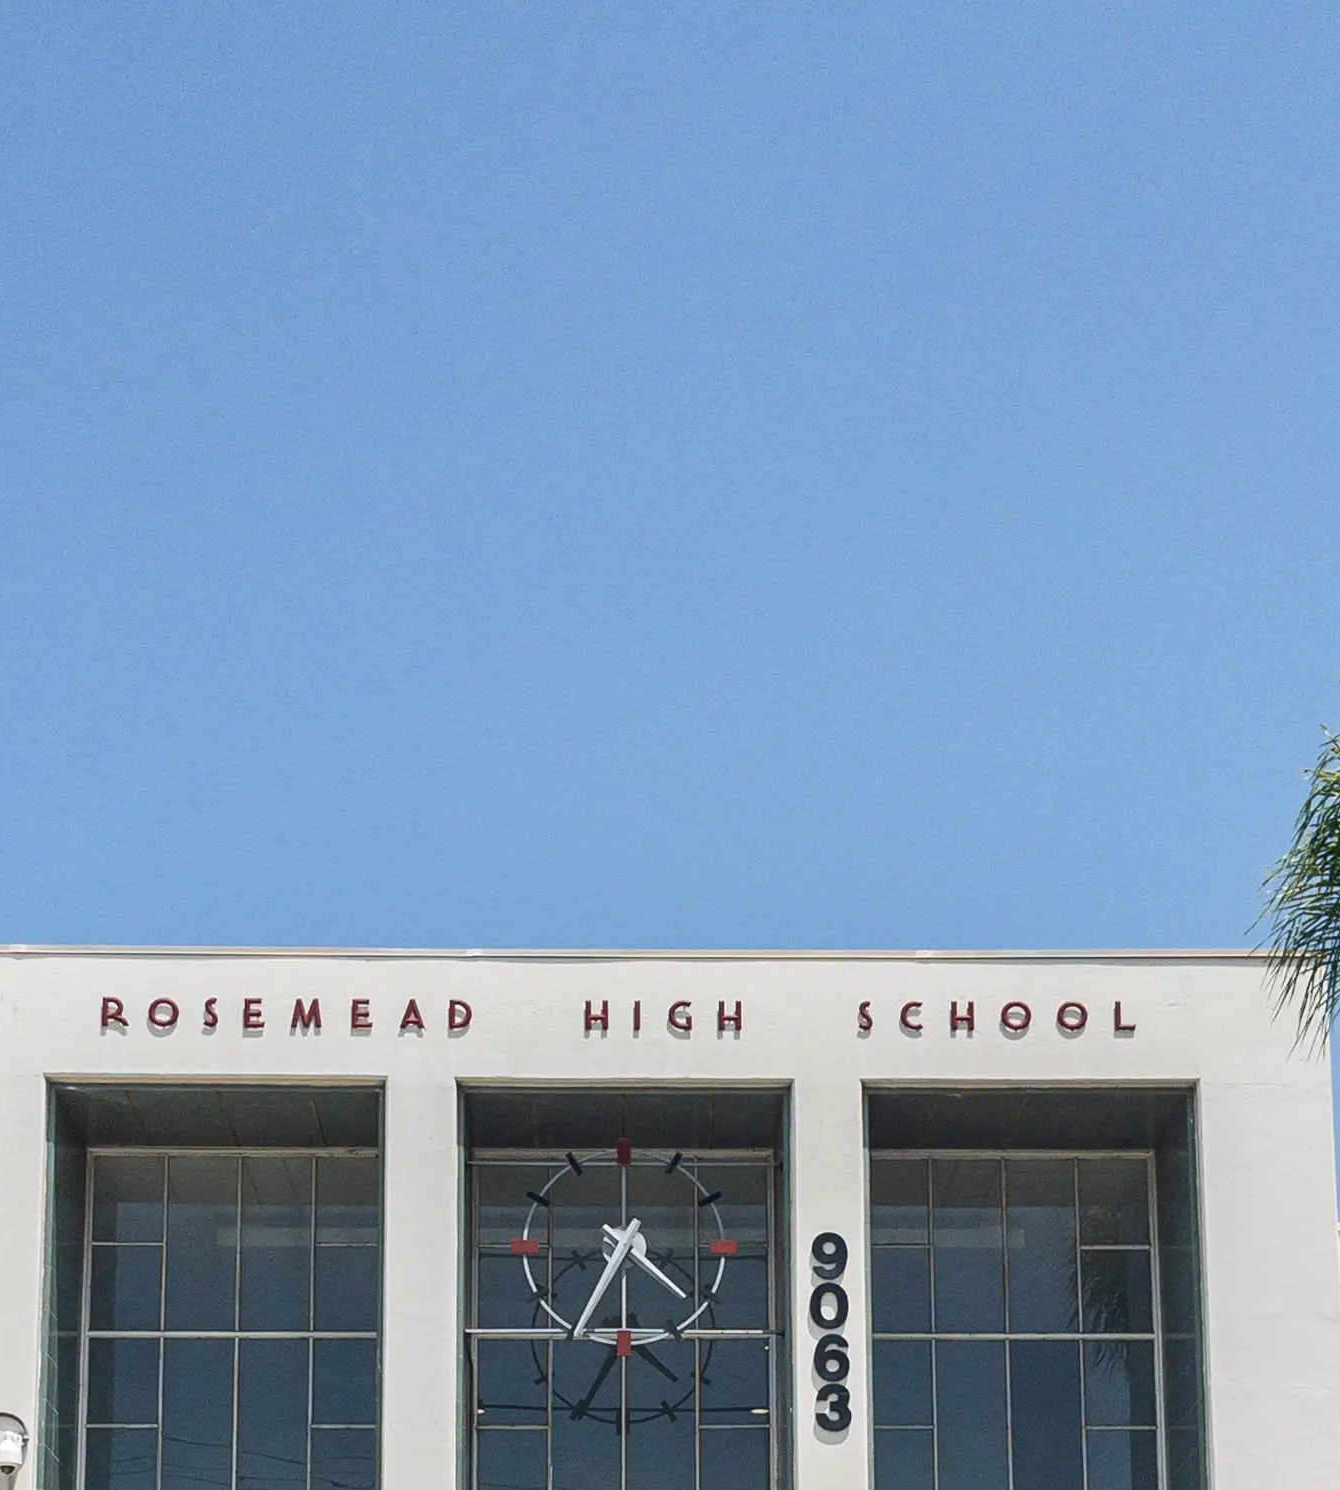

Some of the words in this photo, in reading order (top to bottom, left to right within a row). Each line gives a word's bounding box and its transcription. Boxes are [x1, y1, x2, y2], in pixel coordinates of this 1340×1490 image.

[101, 996, 473, 1030] ROSEMEAD
[584, 1000, 742, 1032] HIGH
[857, 1000, 1136, 1032] SCHOOL
[809, 1231, 852, 1432] 9063
